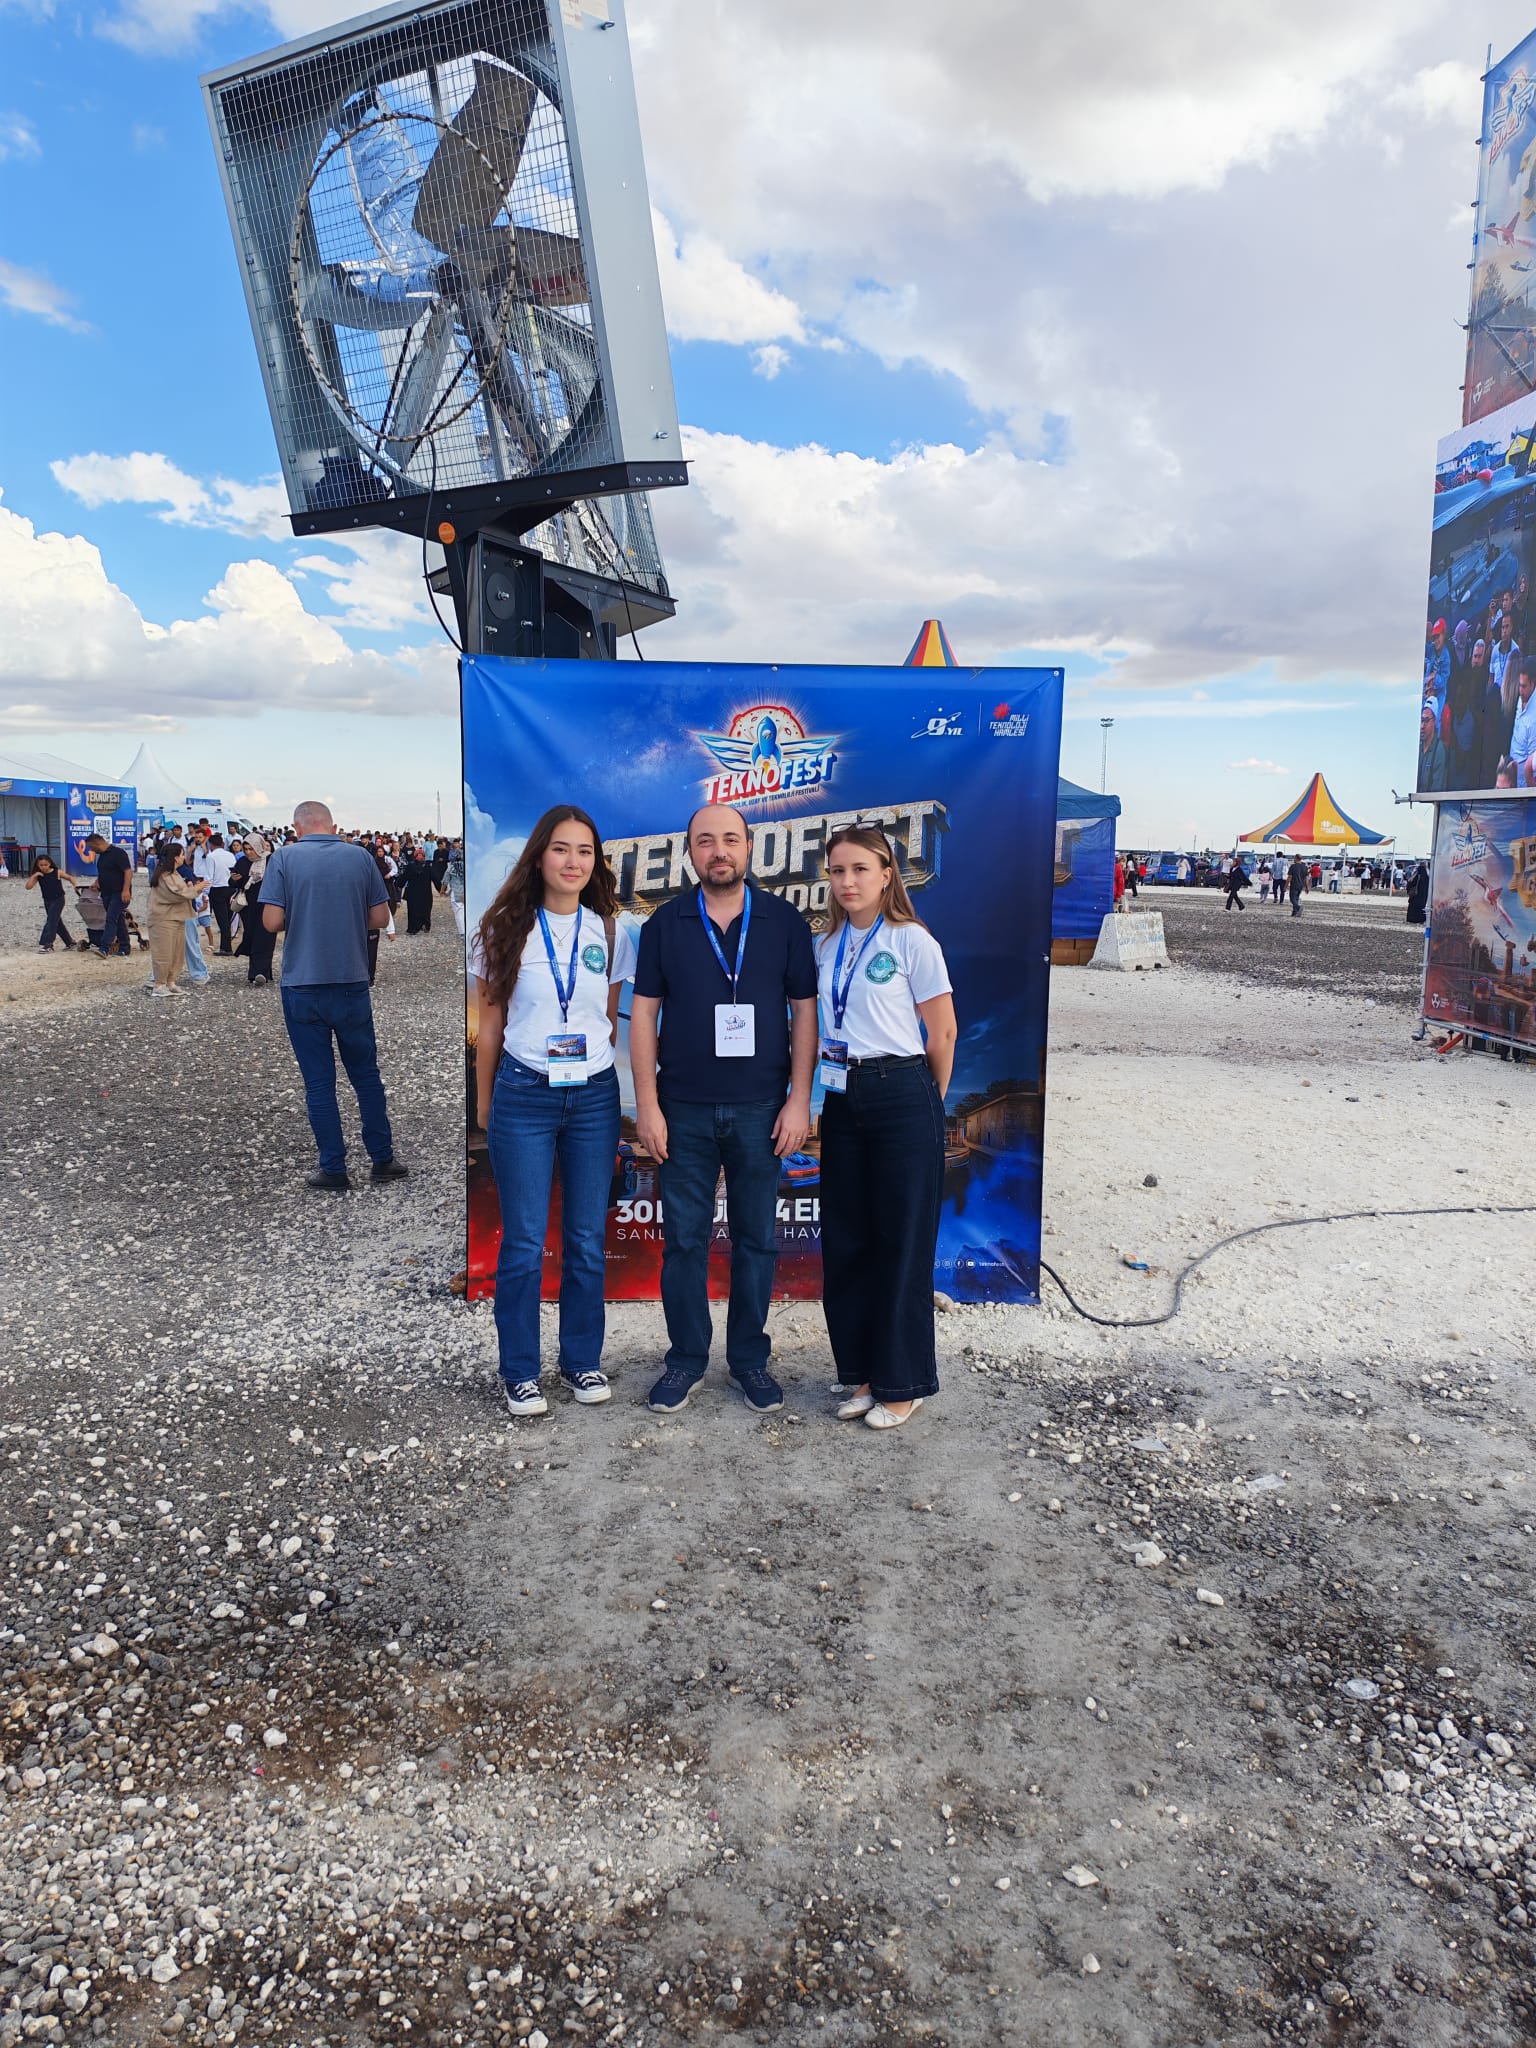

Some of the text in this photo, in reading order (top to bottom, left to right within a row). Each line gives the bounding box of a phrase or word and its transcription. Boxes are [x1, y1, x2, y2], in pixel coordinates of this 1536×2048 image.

[705, 752, 837, 804] TEKNOFEST
[615, 1200, 653, 1224] 30
[775, 1198, 790, 1221] 4
